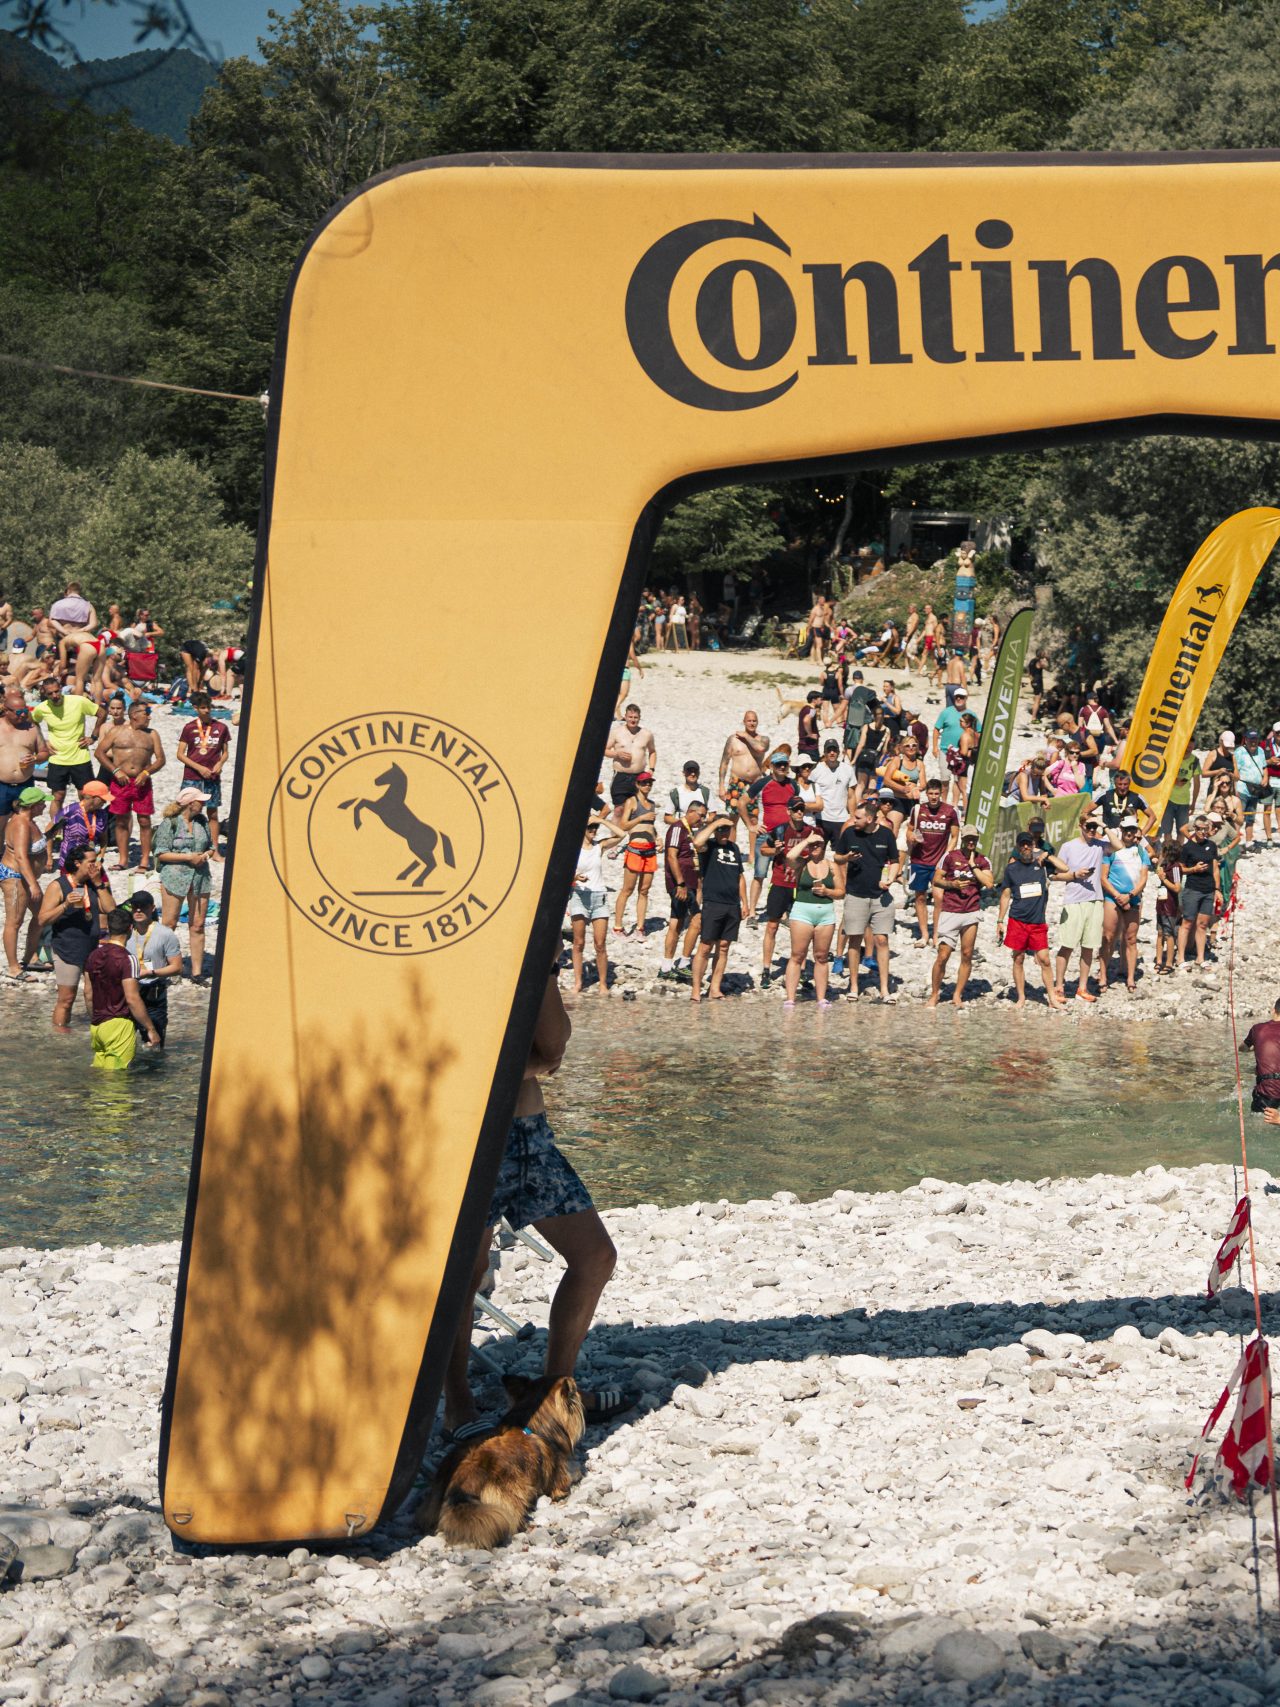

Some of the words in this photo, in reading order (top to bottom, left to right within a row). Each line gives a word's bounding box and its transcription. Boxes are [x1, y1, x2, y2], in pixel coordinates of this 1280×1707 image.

[986, 638, 1022, 777] SLOVENIA
[1131, 606, 1217, 788] Continental
[286, 720, 500, 802] CONTINENTAL
[309, 895, 413, 948] SINCE
[422, 893, 489, 943] 1871
